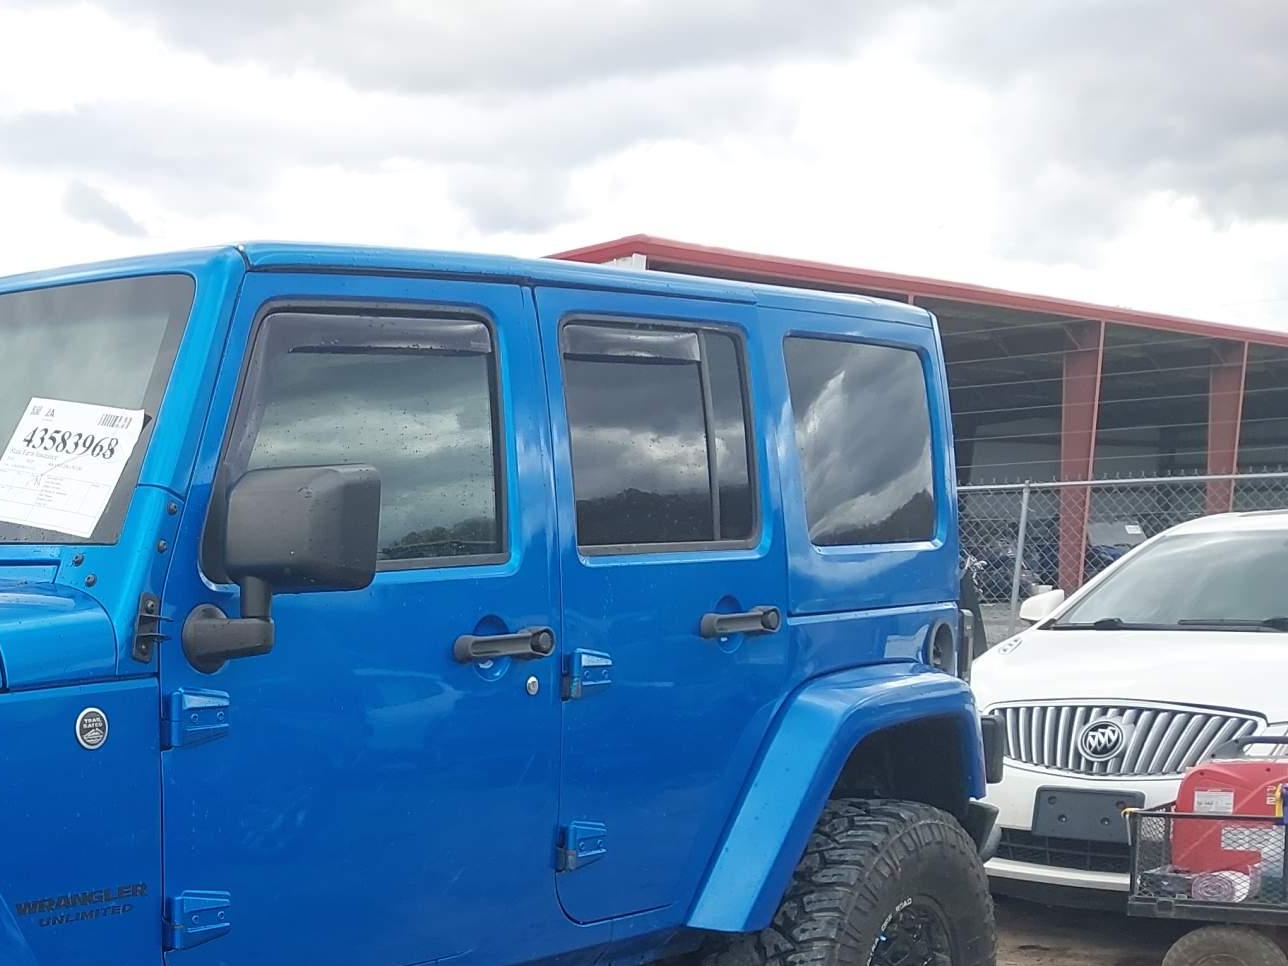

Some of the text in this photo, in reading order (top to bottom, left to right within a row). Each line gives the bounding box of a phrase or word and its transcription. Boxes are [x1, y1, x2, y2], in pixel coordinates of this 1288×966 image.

[23, 426, 119, 460] 43583968
[16, 882, 148, 916] WRANGLER
[39, 902, 134, 928] UNLIMITED
